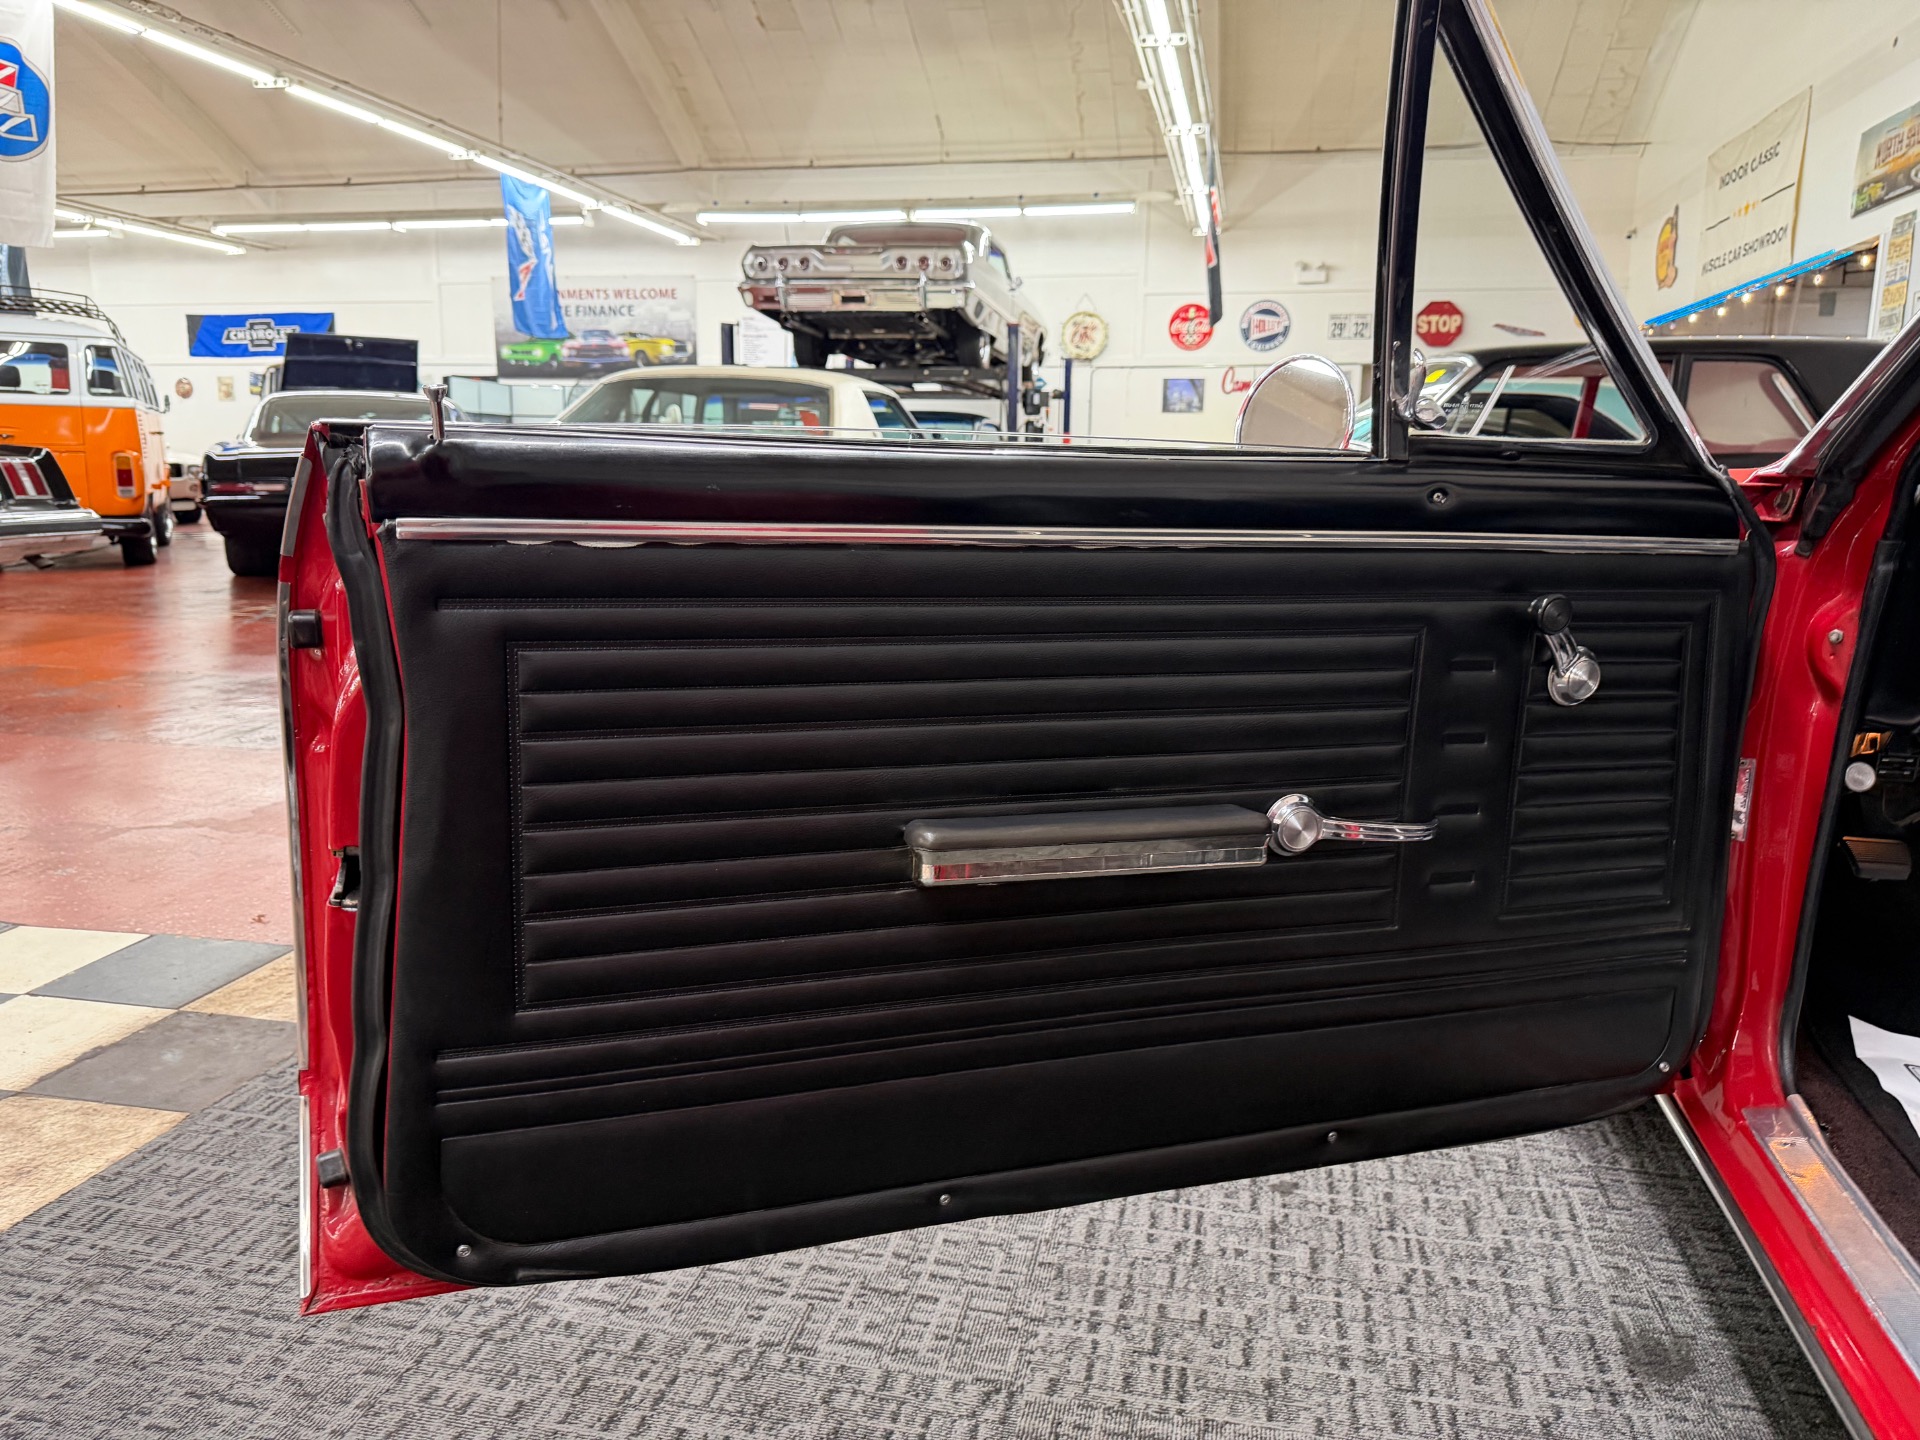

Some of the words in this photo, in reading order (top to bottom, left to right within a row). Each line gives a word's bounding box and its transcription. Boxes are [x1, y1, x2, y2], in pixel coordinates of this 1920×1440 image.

[1719, 161, 1749, 190] INDOOR
[1750, 141, 1781, 173] CLASSIC
[1701, 252, 1727, 277] MUSCLE
[1727, 244, 1742, 265] CAR
[1741, 222, 1790, 258] SHOWROOM
[613, 287, 678, 300] WELCOME
[575, 304, 636, 318] FINANCE
[1416, 313, 1462, 335] STOP
